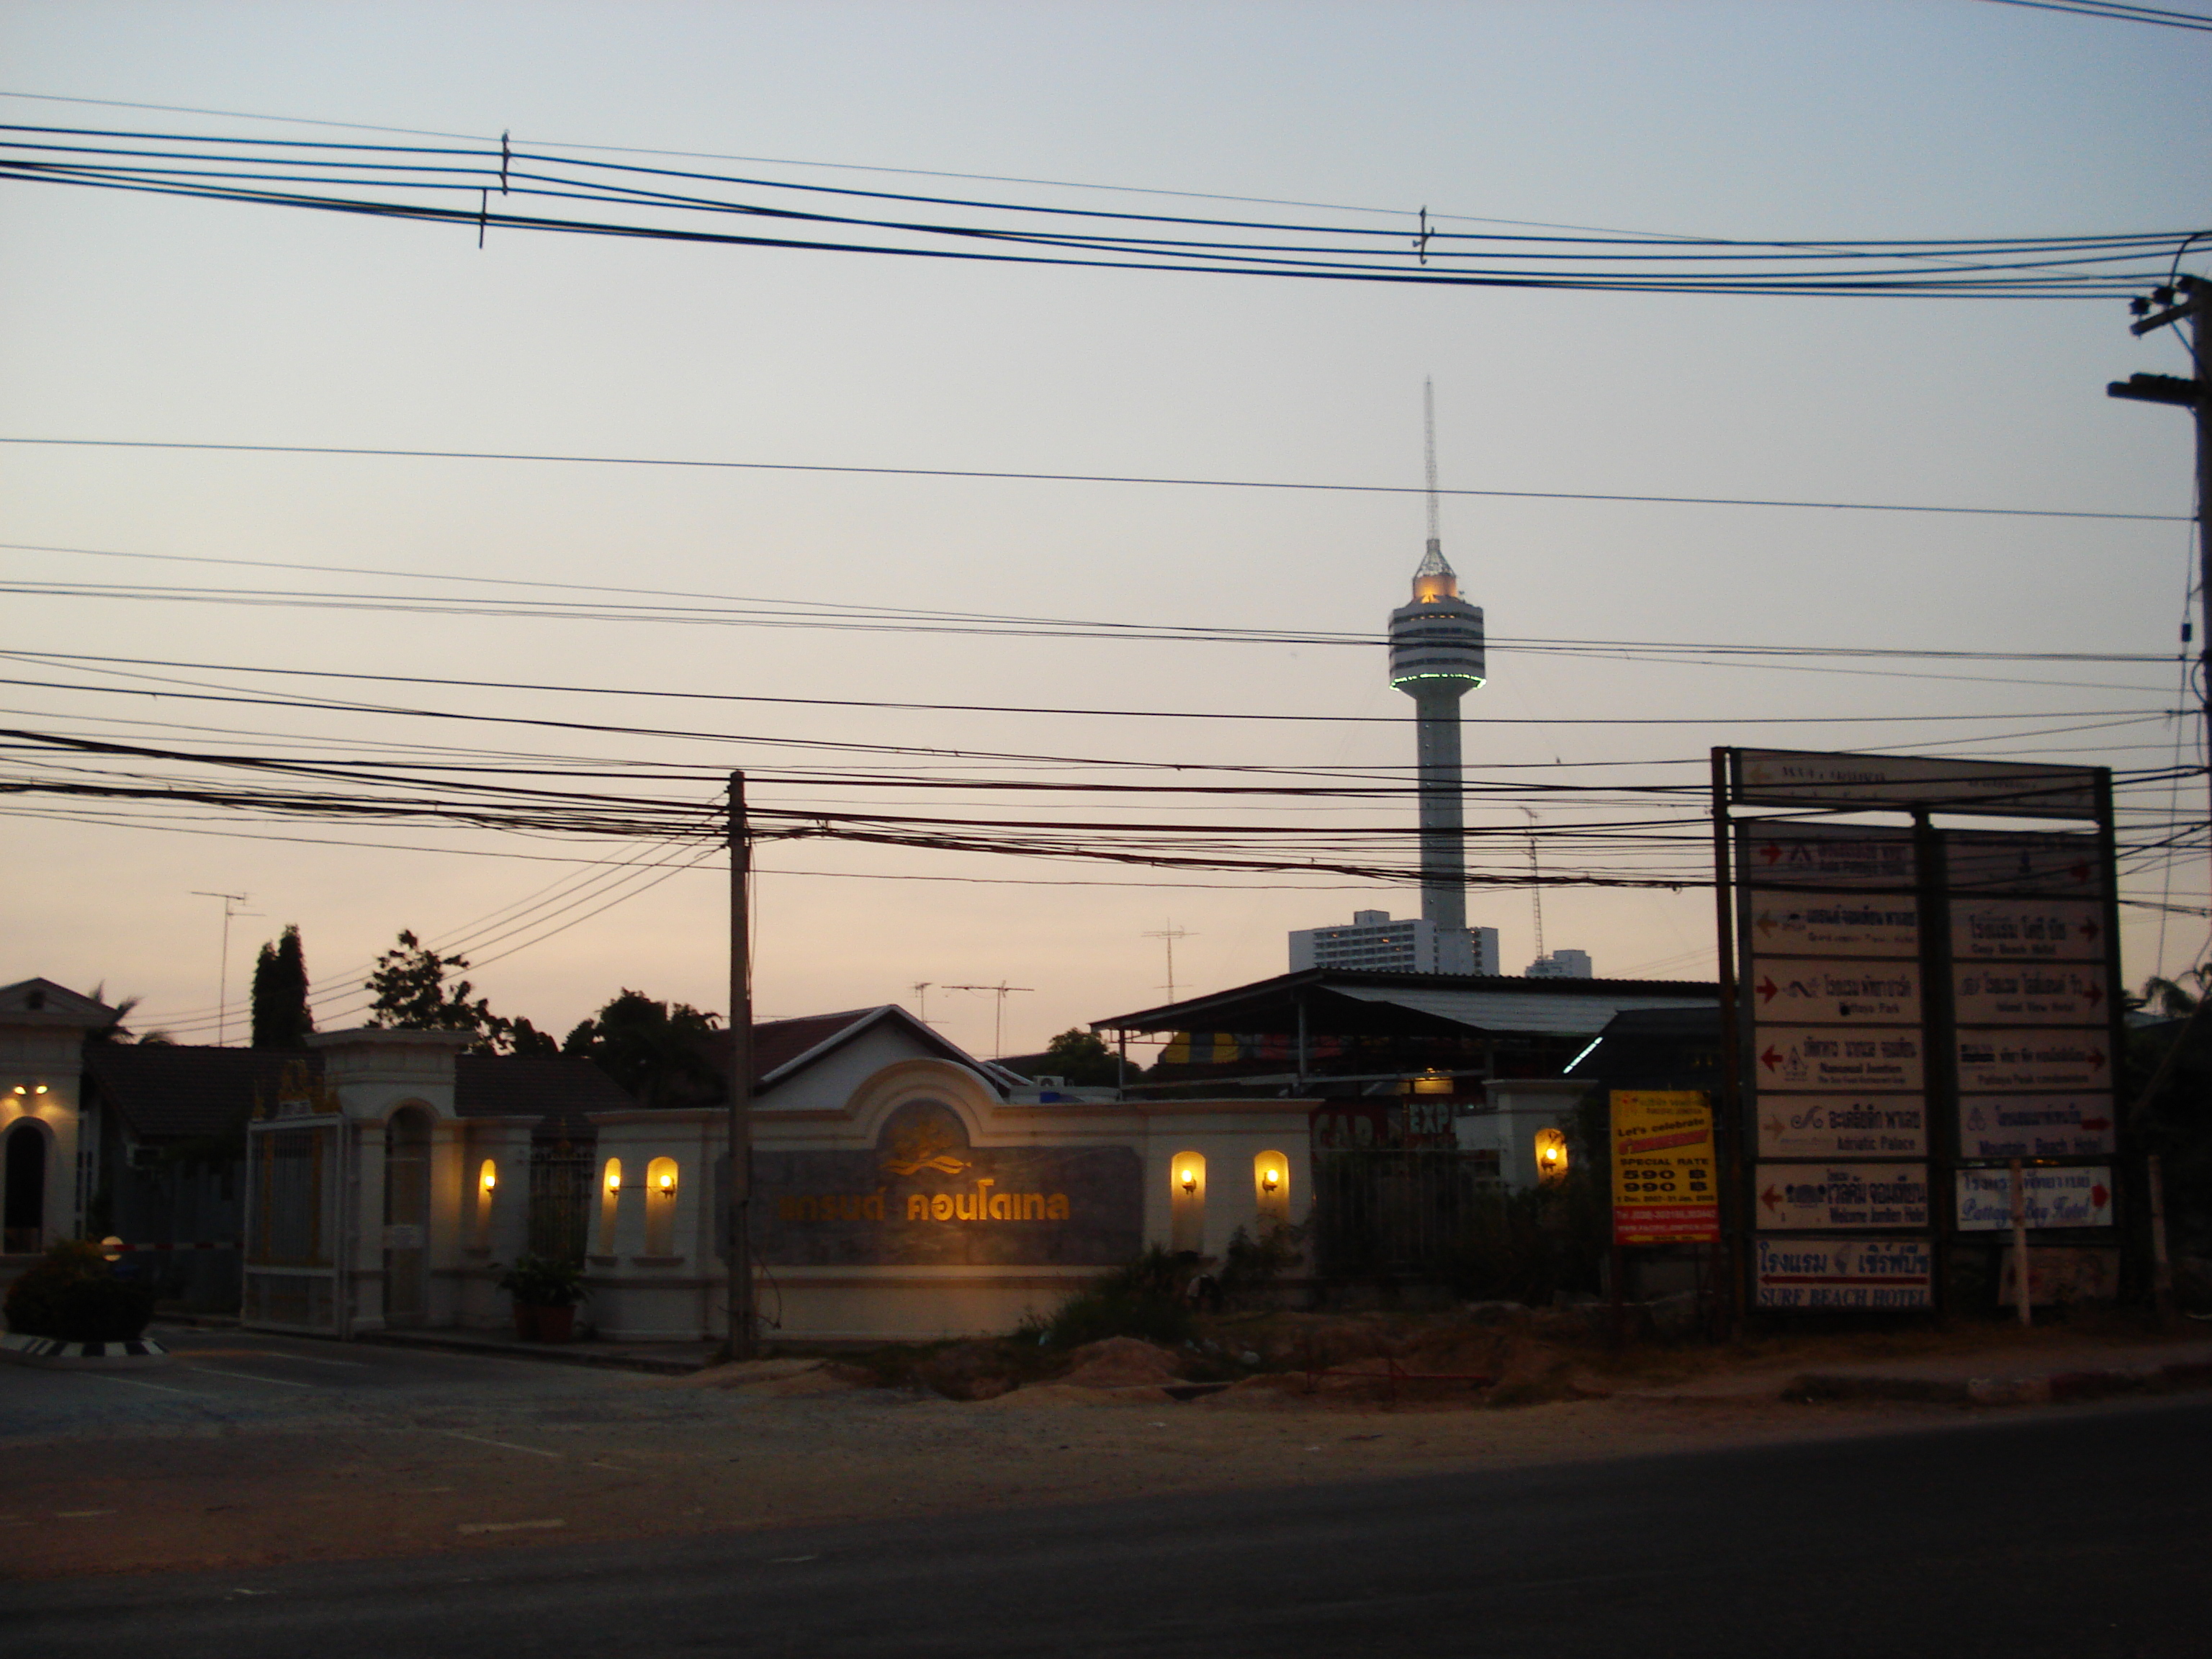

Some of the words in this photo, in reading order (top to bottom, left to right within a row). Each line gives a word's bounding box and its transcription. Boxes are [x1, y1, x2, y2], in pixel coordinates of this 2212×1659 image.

[1618, 1125, 1646, 1137] Let's
[1652, 1118, 1704, 1132] celebrate
[1623, 1170, 1676, 1179] 590
[1624, 1182, 1676, 1192] 990
[907, 1178, 1071, 1221] คอนโดเทล
[1759, 1241, 1827, 1272] โรงแรม
[1760, 1288, 1805, 1307] SURF
[1810, 1288, 1867, 1307] BEACH
[1873, 1288, 1925, 1307] HOTEL
